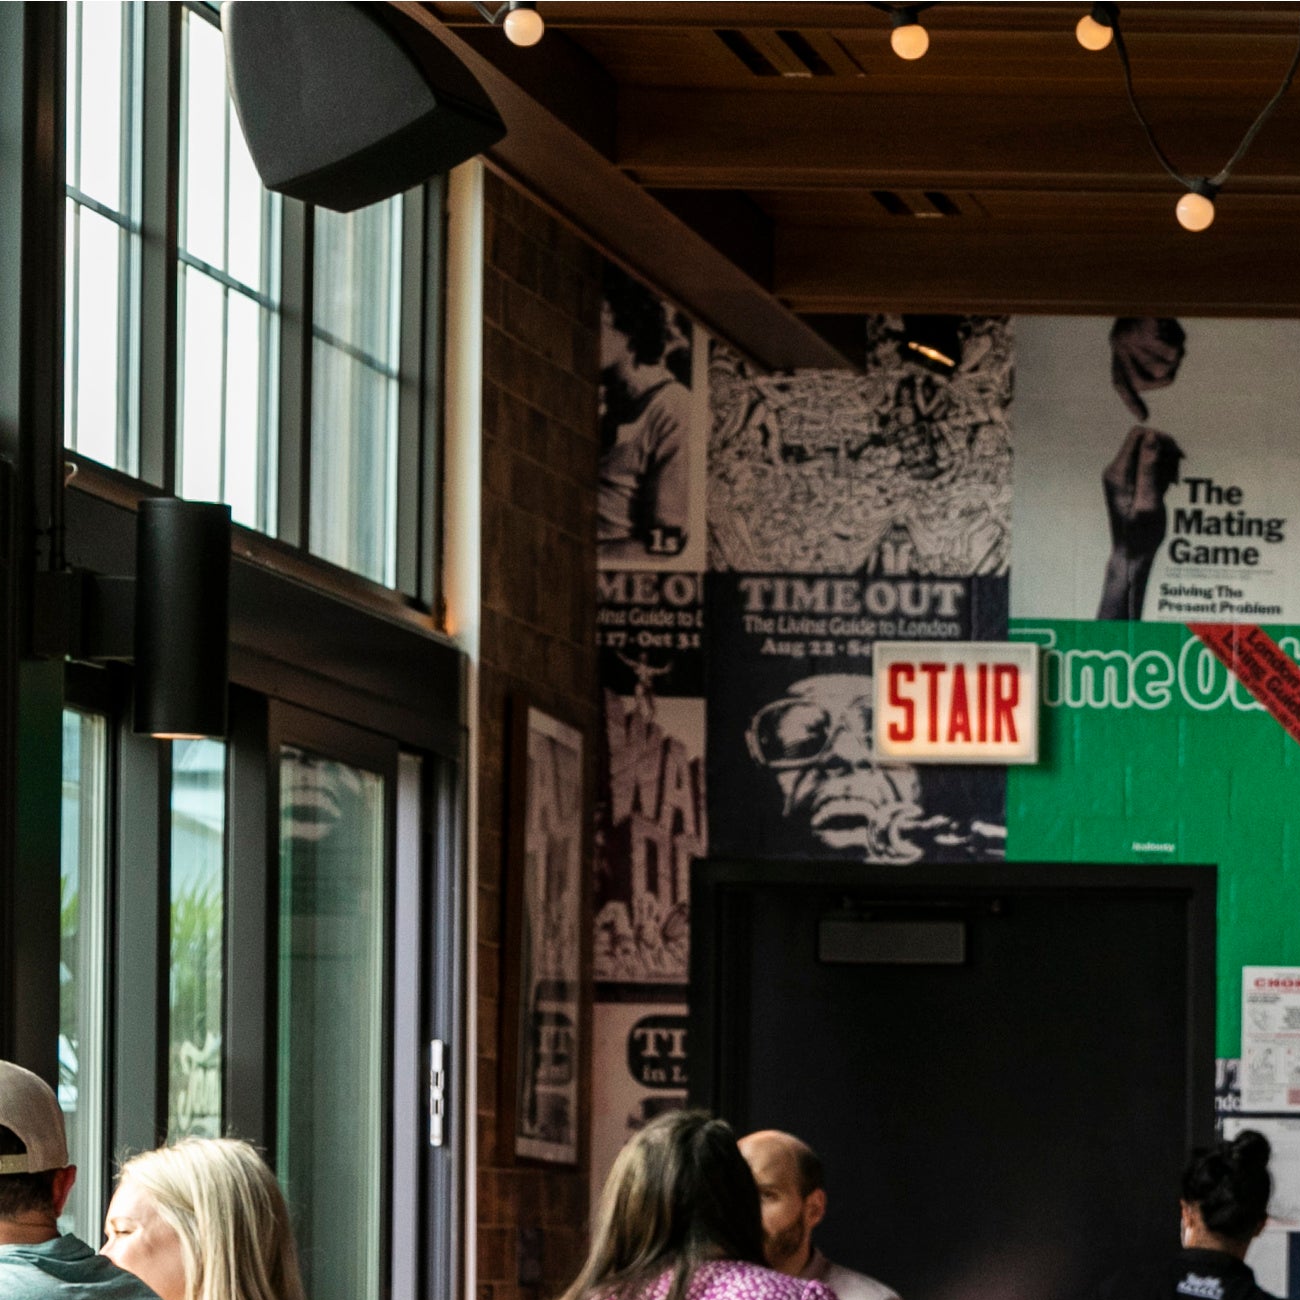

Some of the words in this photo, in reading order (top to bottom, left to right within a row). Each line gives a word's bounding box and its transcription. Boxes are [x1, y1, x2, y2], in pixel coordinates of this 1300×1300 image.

[1182, 477, 1244, 505] The
[1173, 507, 1287, 543] Mating
[1168, 537, 1260, 566] Game
[597, 571, 659, 604] ME
[739, 577, 861, 615] TIME
[864, 580, 967, 618] OUT
[1160, 582, 1213, 599] Solving
[1215, 584, 1243, 598] The
[1157, 598, 1218, 613] Present
[1219, 601, 1282, 615] Problem
[743, 614, 777, 634] The
[777, 614, 827, 638] Living
[828, 616, 877, 637] Guide
[879, 617, 897, 637] to
[898, 617, 961, 638] London
[761, 638, 806, 659] Aug
[1008, 628, 1176, 710] ime
[886, 661, 1020, 744] STAIR
[634, 1027, 687, 1058] TI
